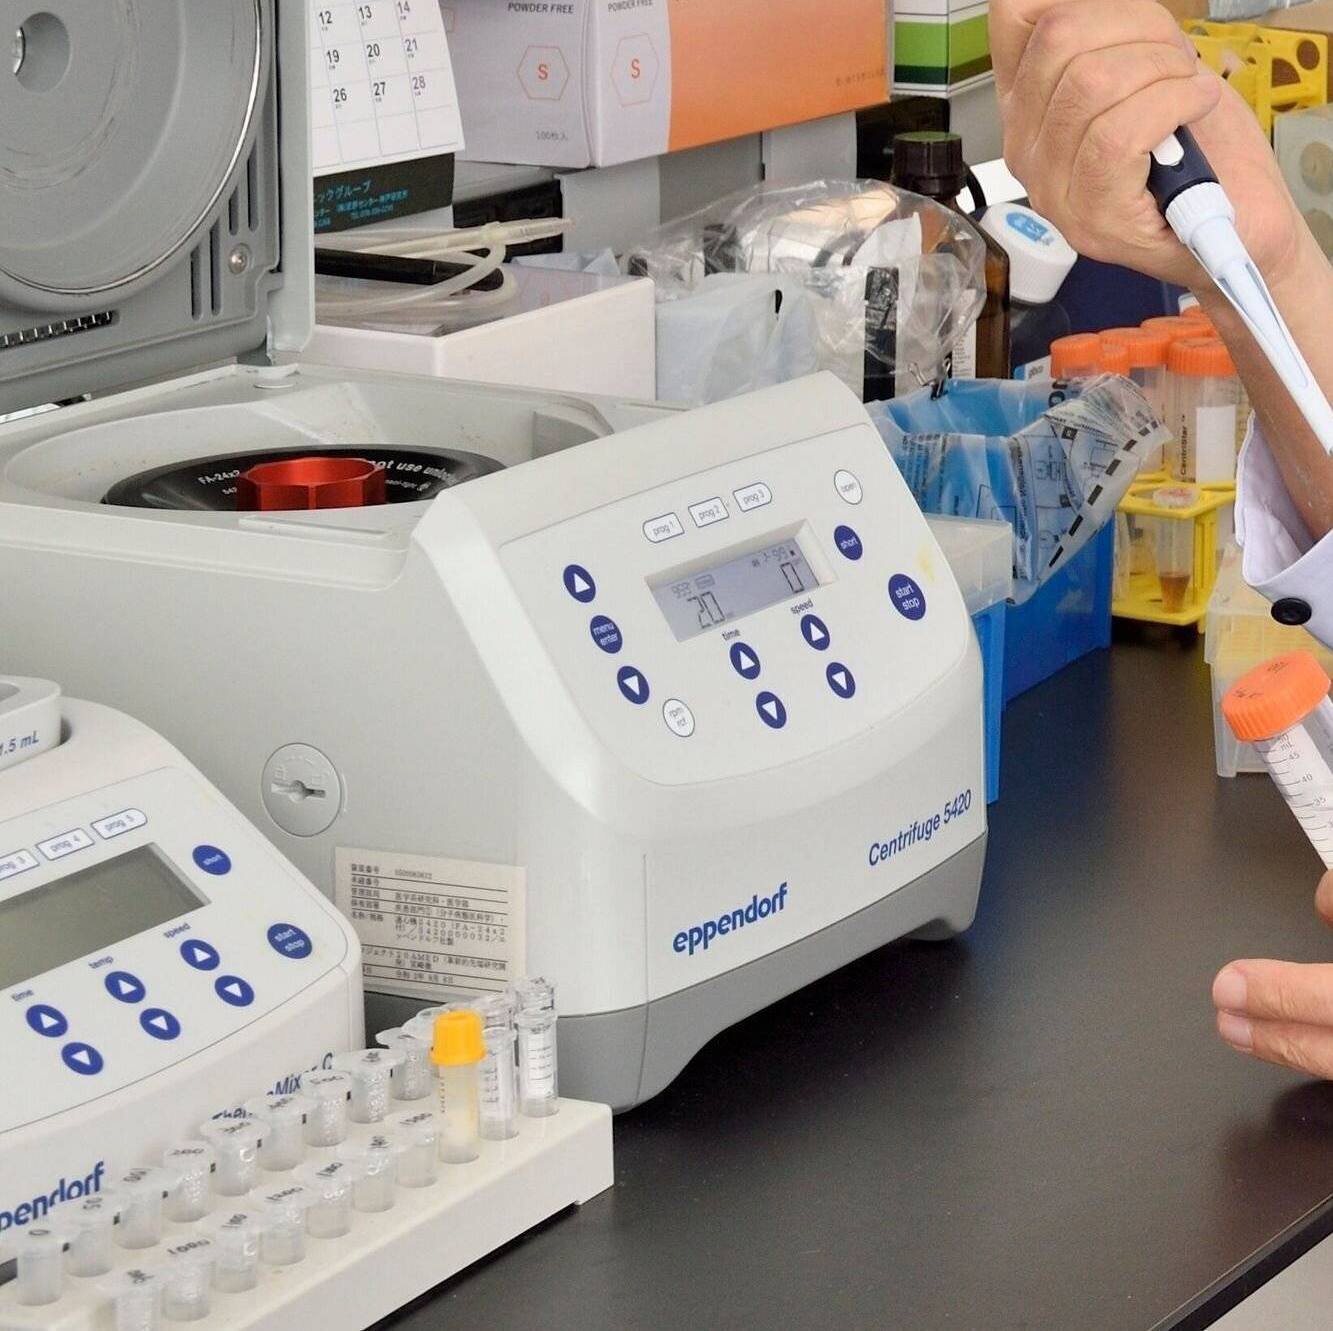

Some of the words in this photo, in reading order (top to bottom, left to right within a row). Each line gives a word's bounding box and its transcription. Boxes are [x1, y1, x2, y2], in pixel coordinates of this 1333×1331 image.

[318, 11, 333, 25] 12
[358, 5, 372, 20] 13
[397, 1, 411, 14] 14
[507, 2, 547, 13] POWDER
[550, 4, 574, 14] FREE
[608, 0, 636, 13] POWDER
[326, 49, 340, 64] 19
[366, 43, 380, 58] 20
[404, 38, 418, 52] 21
[537, 64, 549, 80] S
[630, 58, 641, 79] S
[333, 88, 347, 103] 26
[373, 82, 386, 96] 27
[412, 75, 426, 90] 28
[1180, 424, 1188, 476] CentriStar
[396, 462, 422, 472] use
[743, 493, 760, 505] prog
[758, 489, 765, 499] 3
[698, 508, 716, 520] prog
[714, 505, 722, 515] 2
[652, 524, 671, 537] prog
[840, 537, 859, 550] short
[895, 585, 914, 600] start
[790, 598, 814, 615] speed
[902, 595, 920, 612] stop
[593, 622, 615, 636] menu
[721, 629, 741, 642] time
[600, 632, 619, 646] enter
[668, 706, 685, 720] rpm
[20, 731, 40, 747] mL
[1288, 750, 1300, 761] 45
[1301, 773, 1313, 784] 40
[1314, 796, 1327, 806] 35
[104, 818, 127, 832] prog
[868, 812, 940, 867] Centrifuge
[942, 788, 972, 824] 5420
[50, 839, 72, 853] prog
[16, 856, 26, 865] 3
[202, 852, 223, 867] short
[672, 881, 788, 956] eppendorf
[163, 922, 191, 939] speed
[274, 928, 296, 942] start
[285, 938, 306, 952] stop
[88, 955, 114, 970] temp
[11, 987, 34, 1002] time
[169, 1147, 205, 1156] 200
[167, 1239, 211, 1256] 1000
